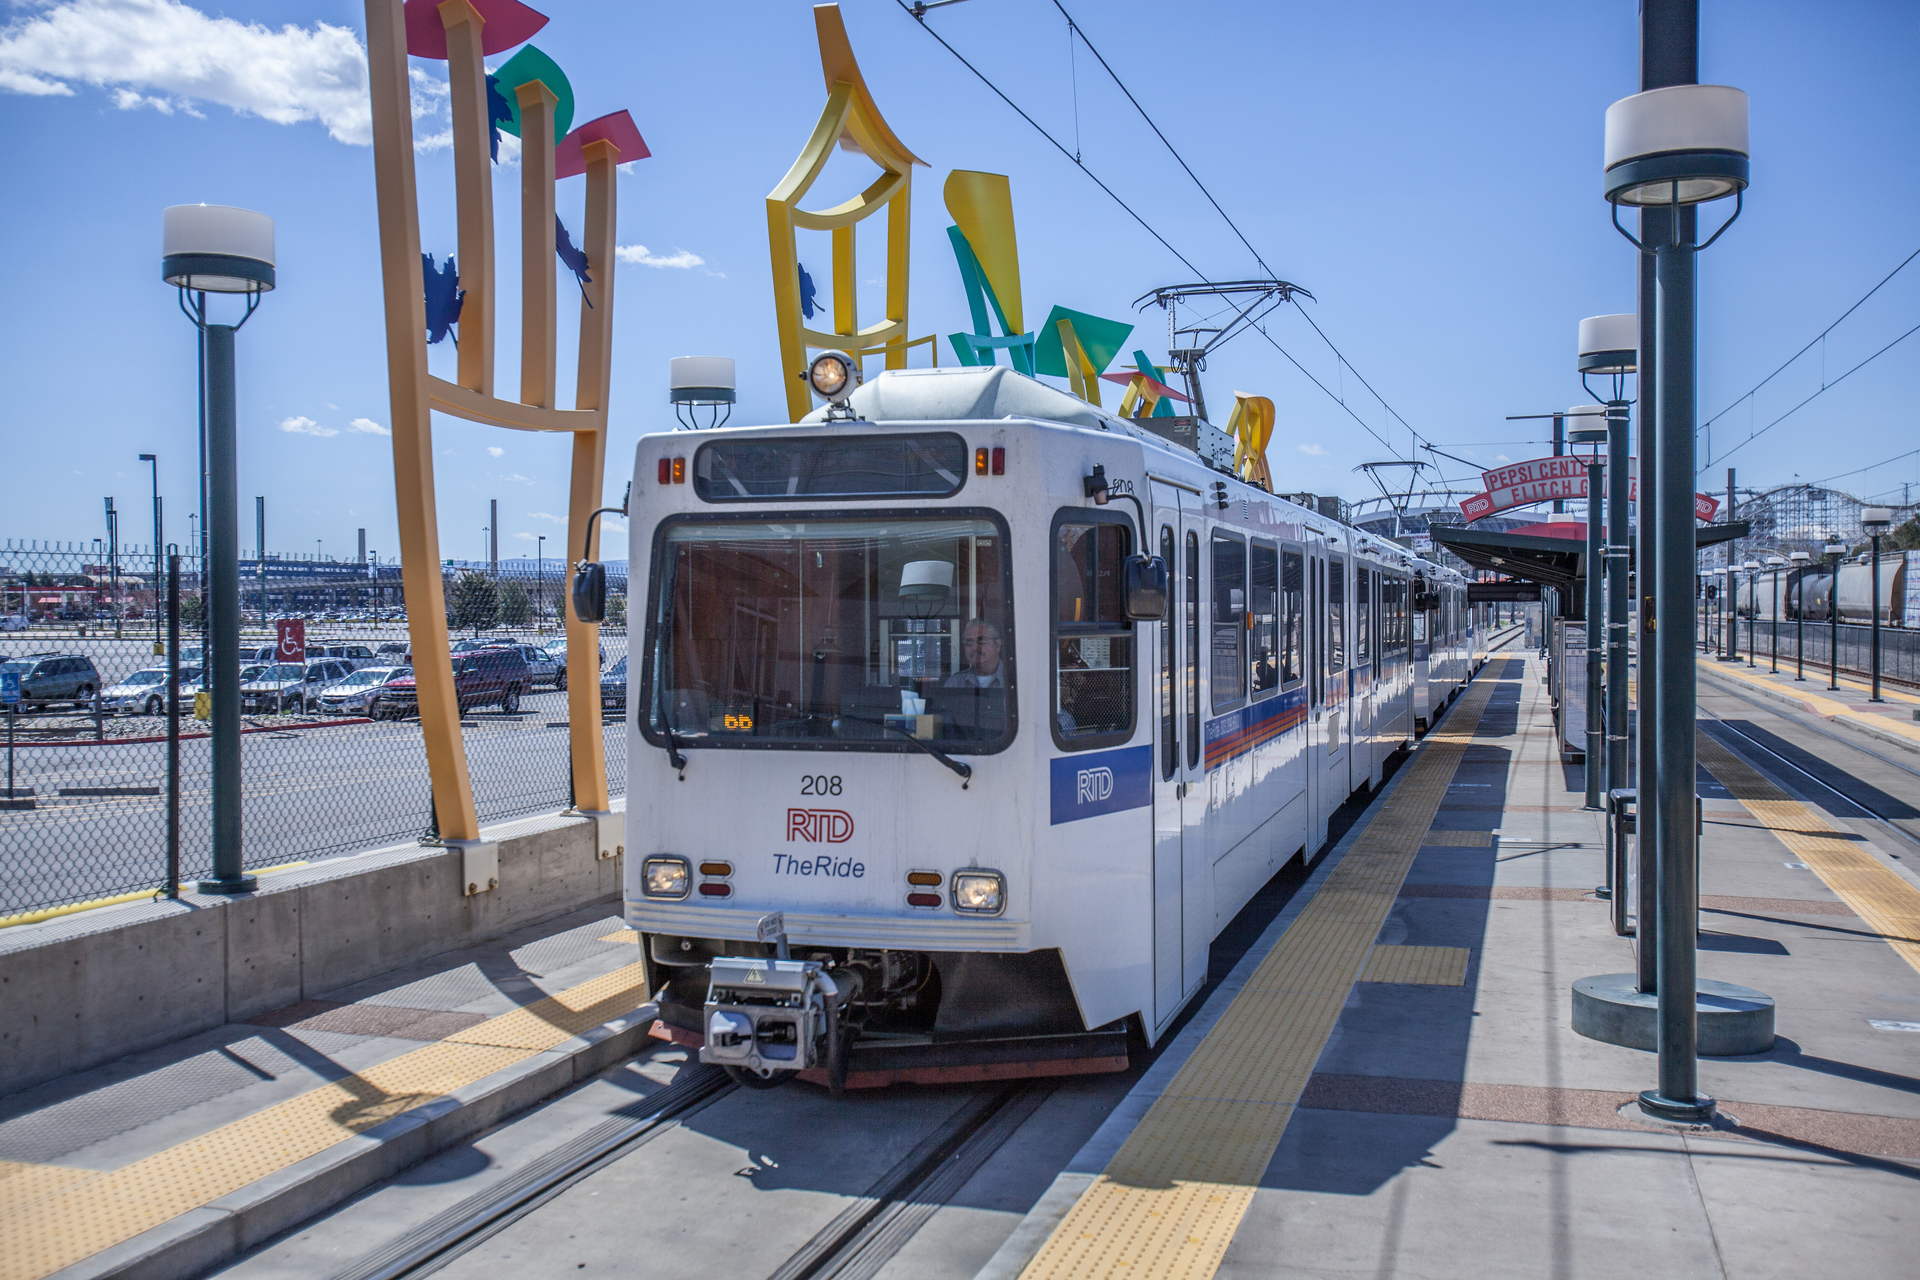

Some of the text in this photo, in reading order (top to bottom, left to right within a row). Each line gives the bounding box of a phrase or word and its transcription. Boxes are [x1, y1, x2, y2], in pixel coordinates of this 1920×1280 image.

[1488, 465, 1533, 491] PEPSI
[1511, 479, 1572, 504] ELITCH
[1466, 498, 1489, 515] RTD
[801, 775, 843, 796] 208
[1077, 766, 1114, 805] RTD
[786, 807, 854, 844] RTD
[773, 853, 865, 878] TheRide
